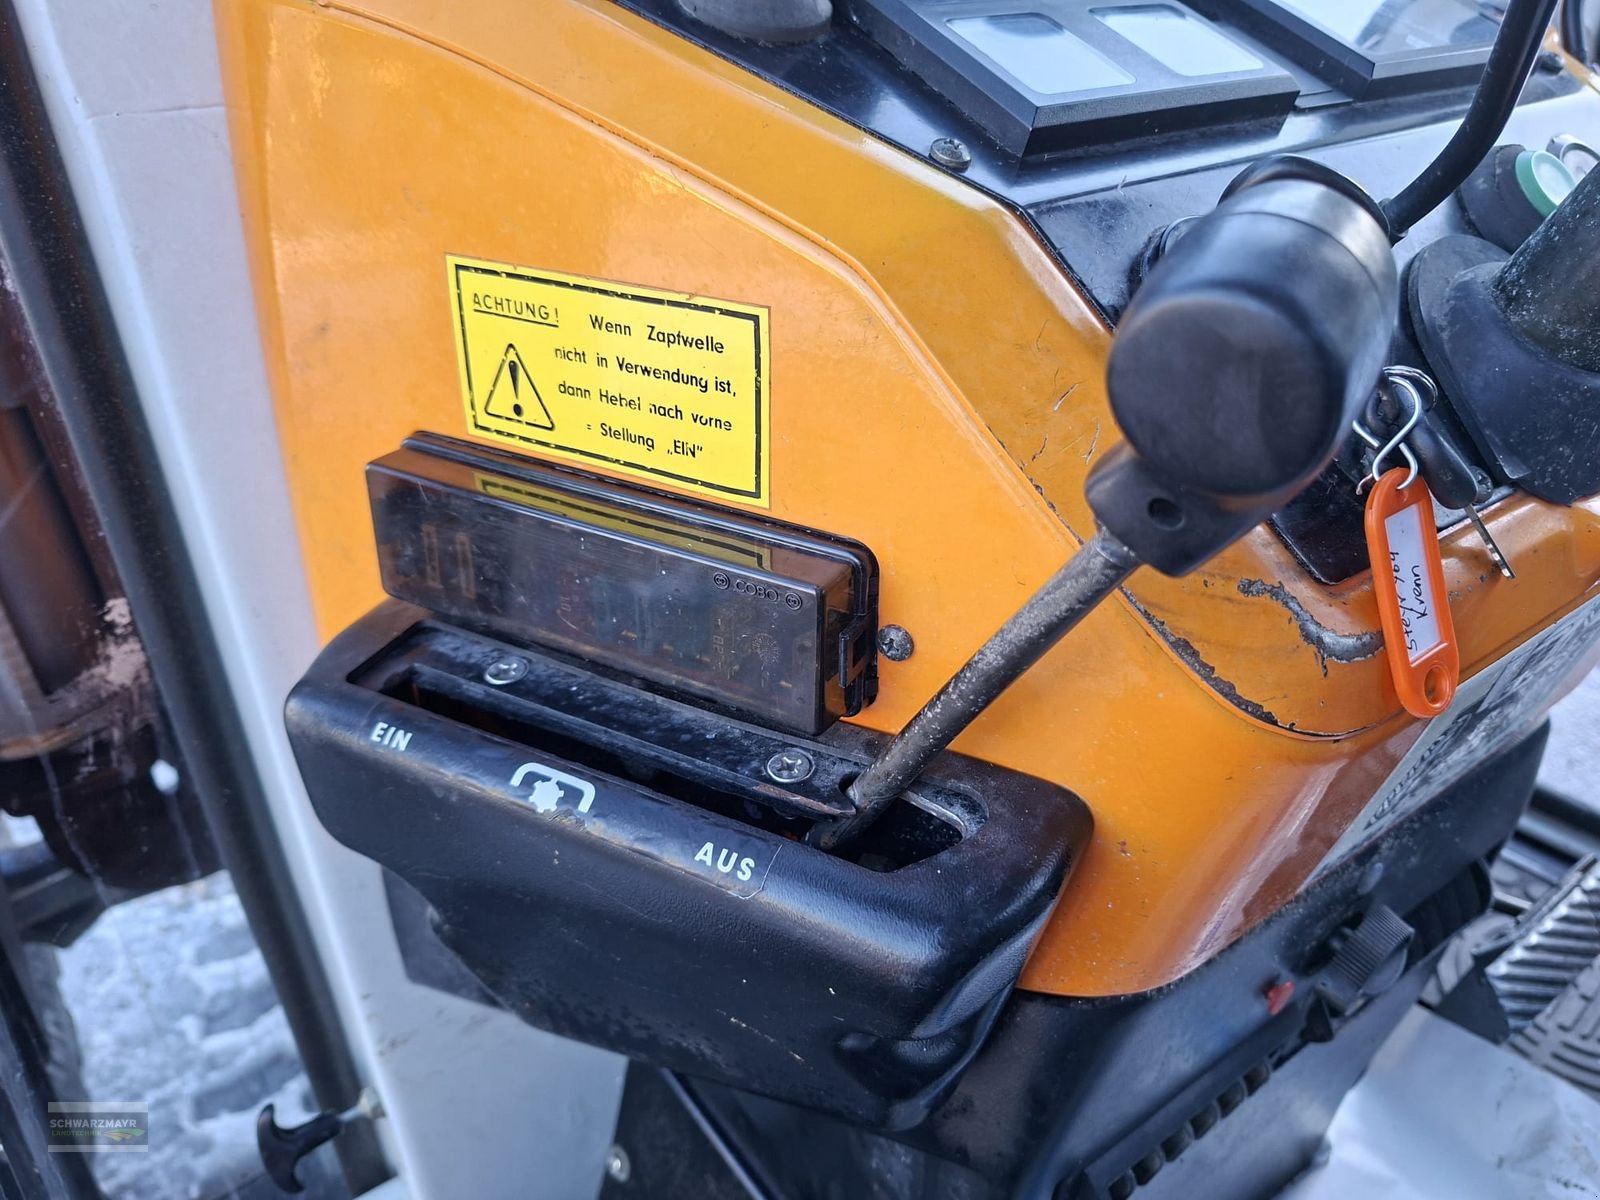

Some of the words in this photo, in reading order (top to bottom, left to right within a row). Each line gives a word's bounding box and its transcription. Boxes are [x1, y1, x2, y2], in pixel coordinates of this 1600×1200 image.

[589, 314, 632, 336] Wenn
[554, 346, 587, 364] nicht
[596, 353, 609, 368] in
[616, 356, 708, 393] Verwendung
[714, 376, 737, 397] ist,
[558, 381, 591, 400] dann
[599, 389, 641, 411] Hebel
[648, 403, 683, 420] nach
[691, 412, 733, 431] vorne
[600, 422, 655, 452] Stellung
[735, 579, 779, 602] COBO
[370, 721, 413, 752] EIN
[694, 841, 756, 882] AUS
